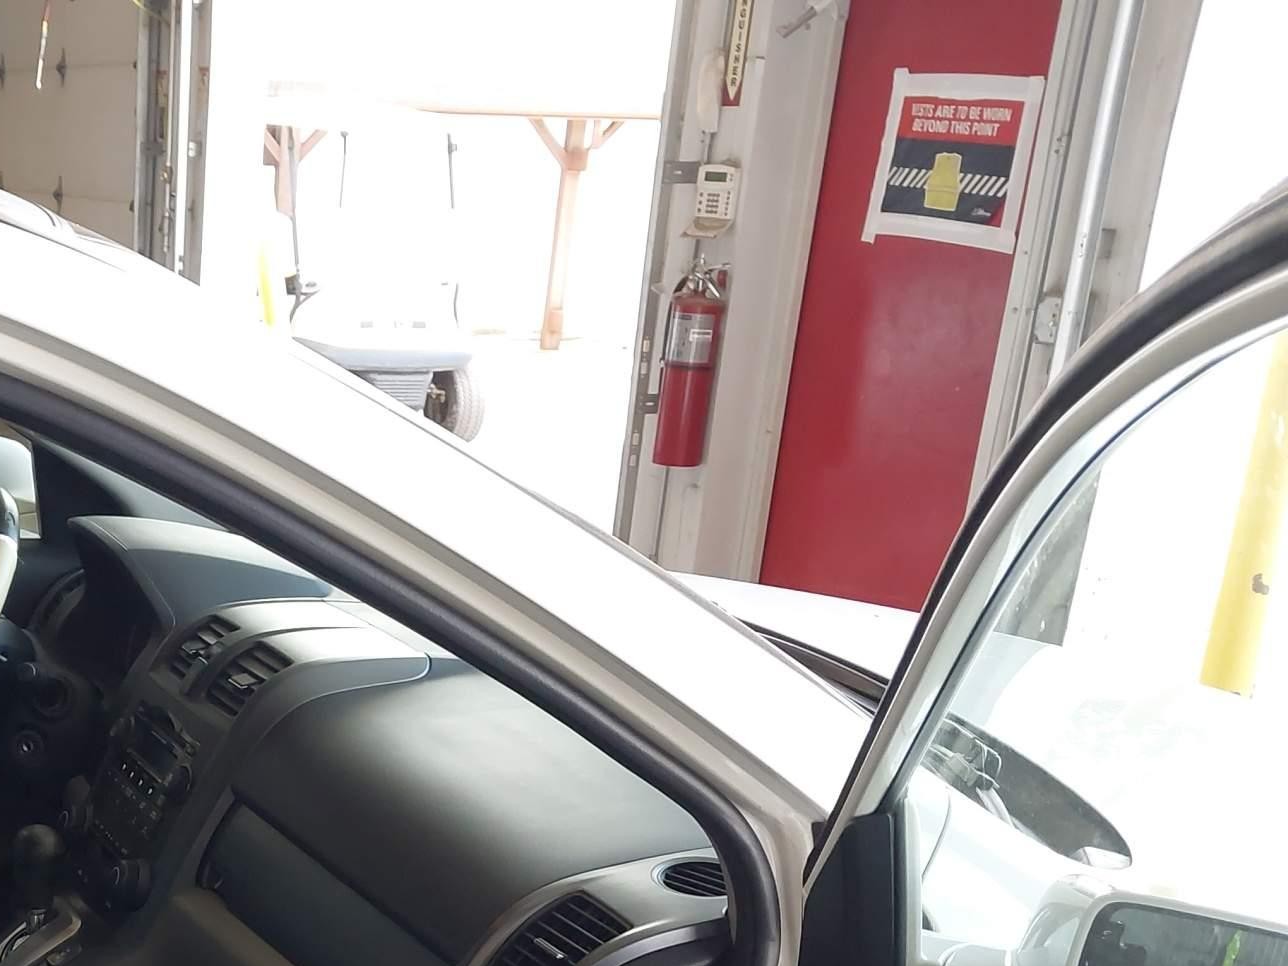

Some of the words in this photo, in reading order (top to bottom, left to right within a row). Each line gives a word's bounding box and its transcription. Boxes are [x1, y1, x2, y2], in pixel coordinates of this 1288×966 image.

[935, 104, 956, 119] ARE
[957, 105, 969, 120] TO
[969, 106, 982, 121] BE
[983, 107, 1012, 123] WORN
[912, 118, 950, 134] BEYOND
[950, 120, 971, 136] THIS
[972, 122, 1000, 138] POINT
